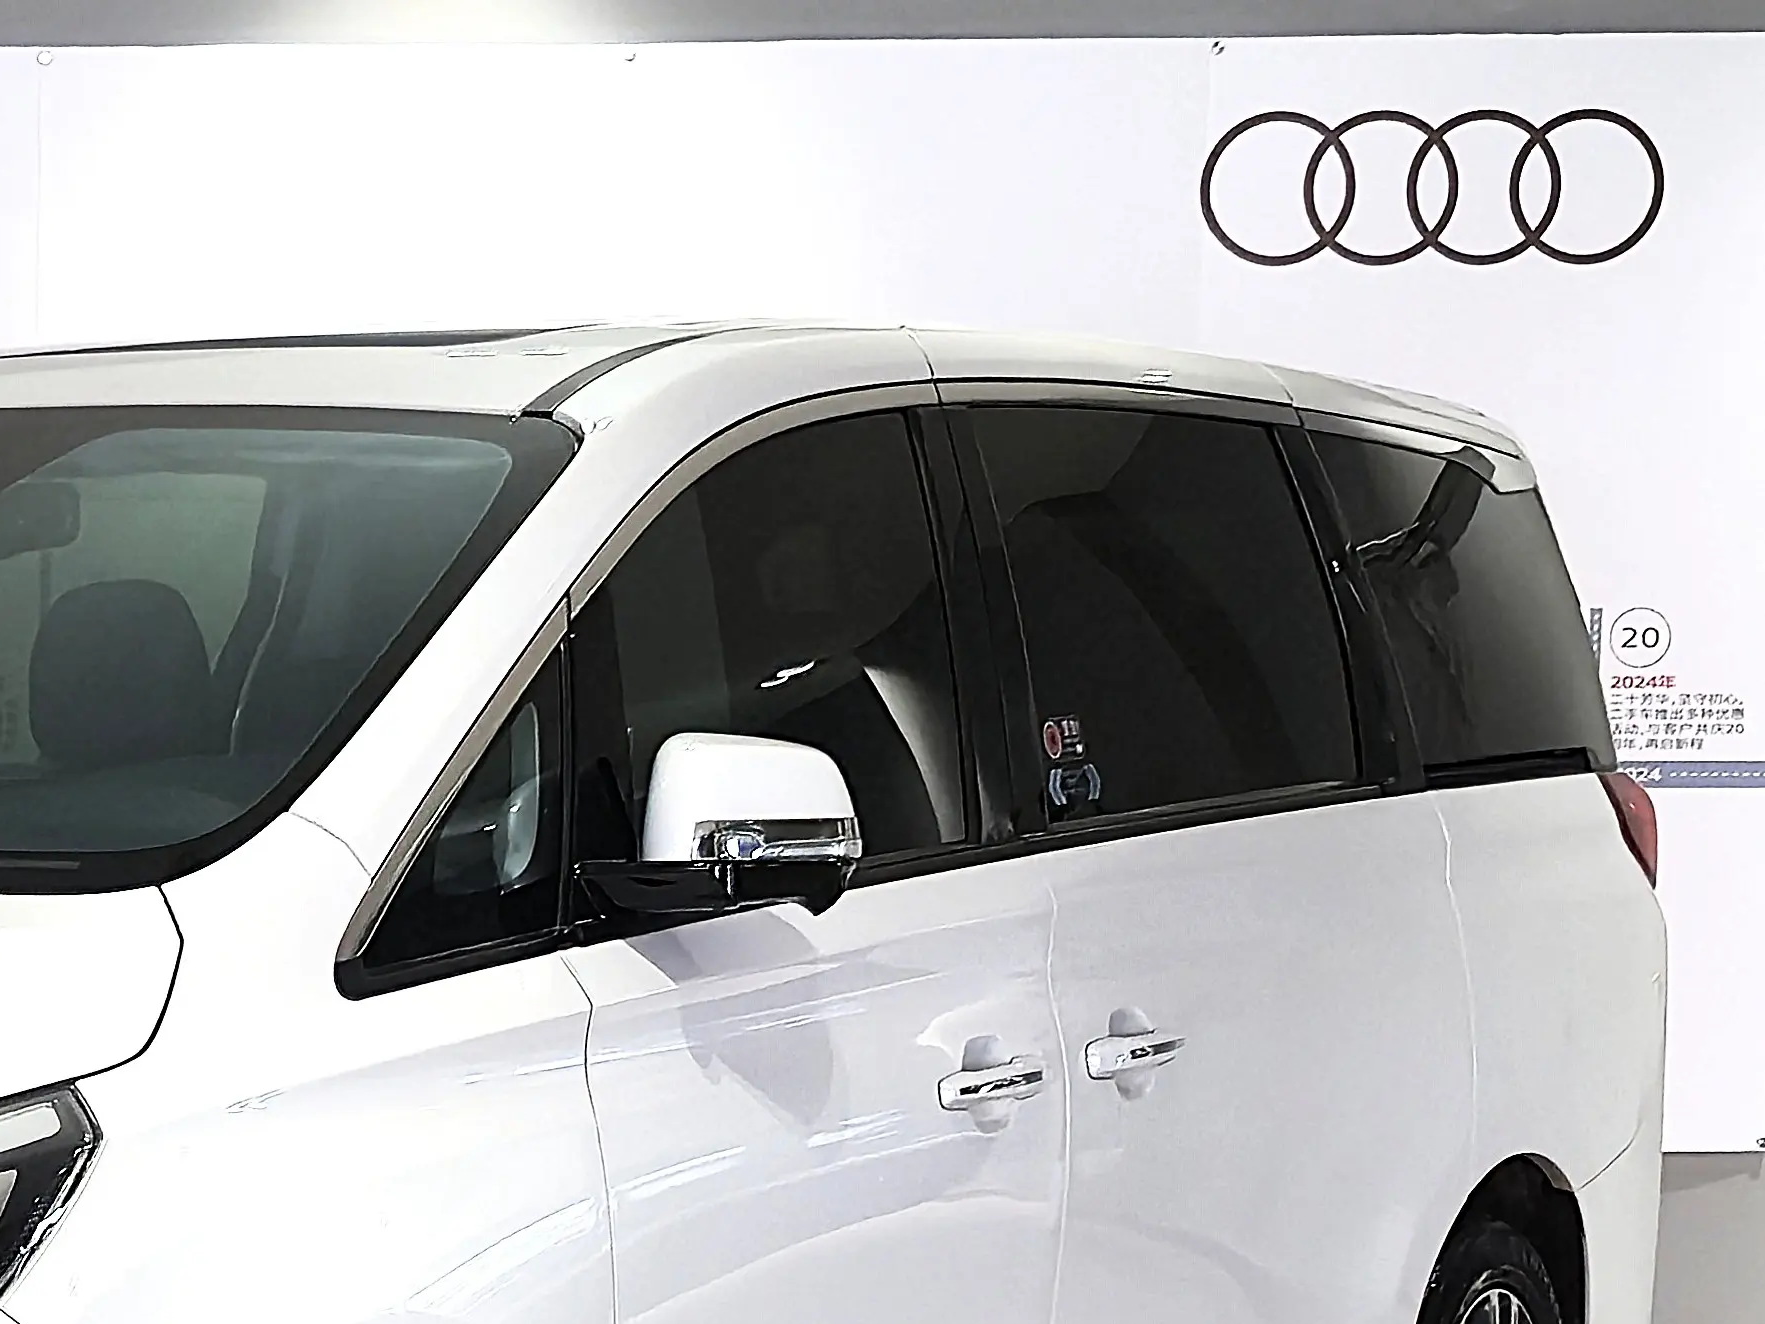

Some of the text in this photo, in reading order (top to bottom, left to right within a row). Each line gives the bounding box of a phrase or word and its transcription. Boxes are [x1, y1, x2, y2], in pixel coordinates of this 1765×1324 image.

[1621, 626, 1661, 650] 20
[1610, 675, 1677, 689] 2024年
[1617, 767, 1663, 783] 024
